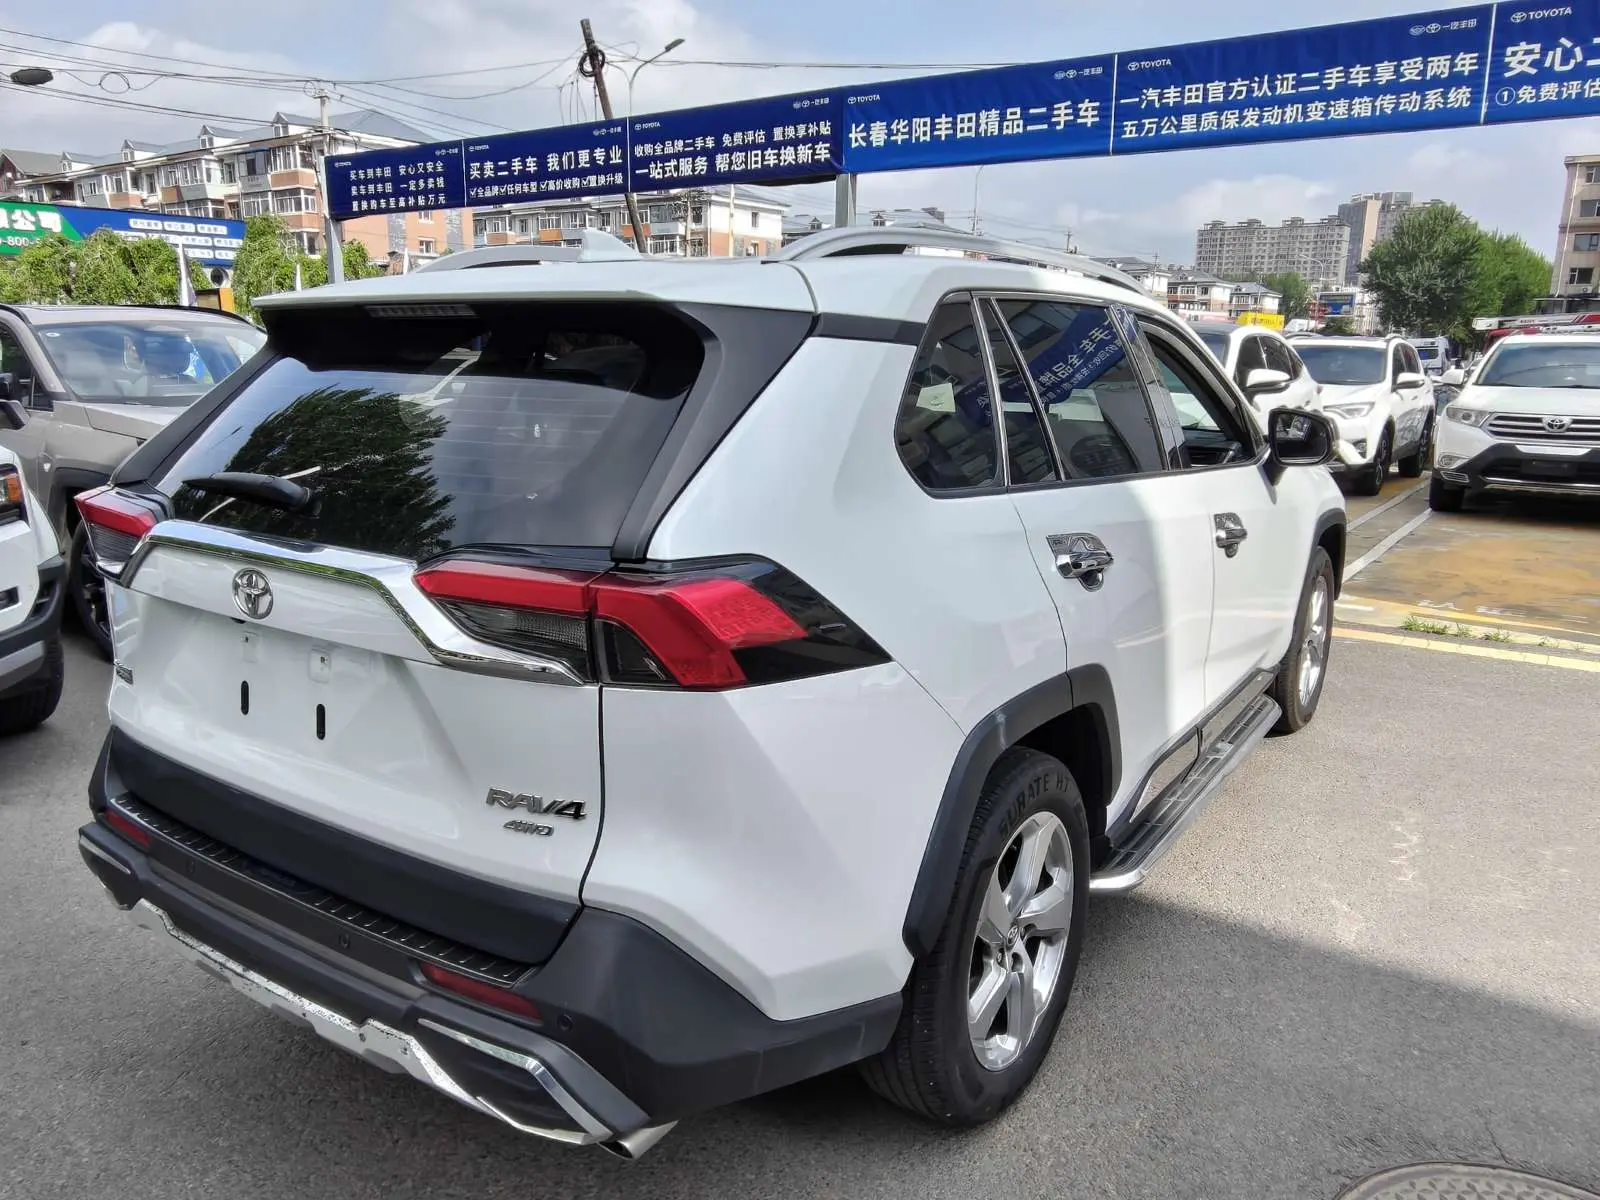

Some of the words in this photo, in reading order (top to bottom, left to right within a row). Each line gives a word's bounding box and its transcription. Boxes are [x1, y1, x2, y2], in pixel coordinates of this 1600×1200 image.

[1528, 7, 1573, 20] TOYOTA
[1140, 58, 1172, 69] TOYOTA
[1119, 51, 1480, 110] 一汽丰田官方认证二手车享受两年
[857, 94, 881, 103] TOYOTA
[848, 98, 1101, 149] 长春华阳丰田精品二手车
[1120, 86, 1473, 139] 五万公里质保发动机变速箱传动系统
[642, 121, 661, 130] TOYOTA
[634, 135, 716, 157] 收购全品牌二手车
[722, 129, 766, 147] 免费评估
[773, 120, 831, 142] 置换享补贴
[398, 160, 444, 176] 安心又安全
[469, 155, 538, 180] 买卖二手车
[546, 144, 623, 172] 我们更专业
[635, 156, 708, 179] 一站式服务
[715, 142, 831, 173] 帮您旧车换新车
[400, 176, 445, 191] 一定多卖钱
[486, 787, 588, 820] RAV4
[503, 820, 555, 837] 4WD
